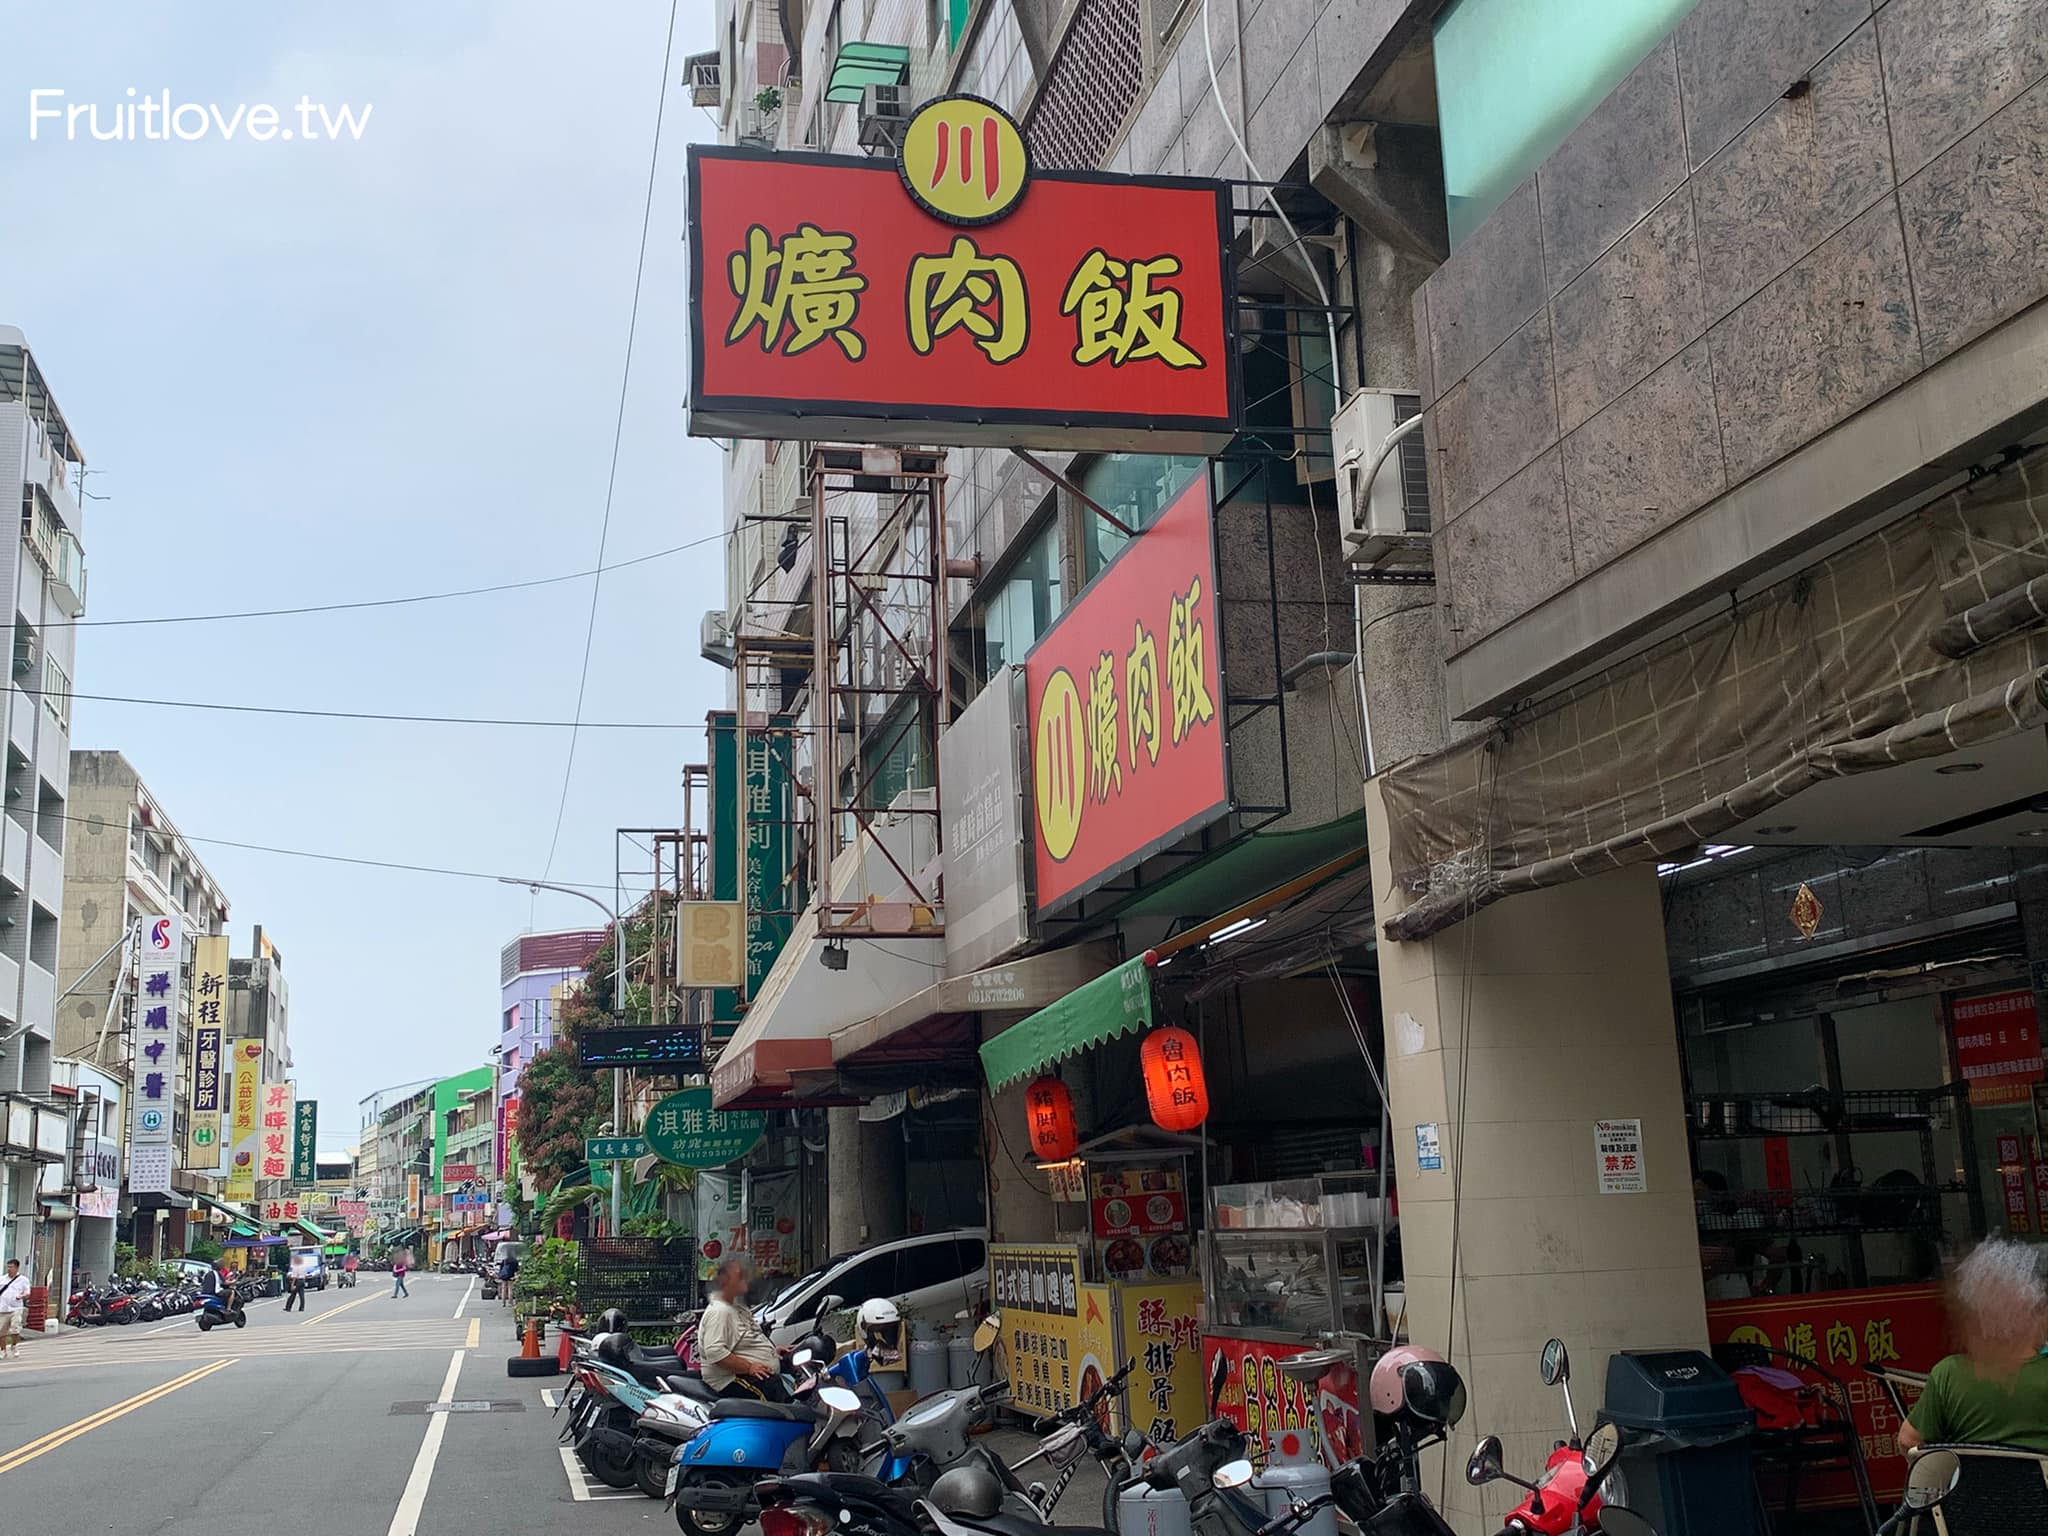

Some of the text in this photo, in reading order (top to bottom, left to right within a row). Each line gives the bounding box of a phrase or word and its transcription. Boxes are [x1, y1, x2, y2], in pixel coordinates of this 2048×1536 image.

[930, 116, 1000, 201] 川
[724, 222, 1207, 369] 爌肉飯
[1086, 574, 1214, 806] 爌肉飯
[1046, 688, 1076, 829] 川
[237, 1071, 253, 1128] 公益彩券
[1162, 1037, 1198, 1107] 魯肉飯
[657, 1108, 728, 1136] 淇雅利
[1605, 1155, 1637, 1170] 禁菸
[1144, 1341, 1178, 1444] 排骨飯
